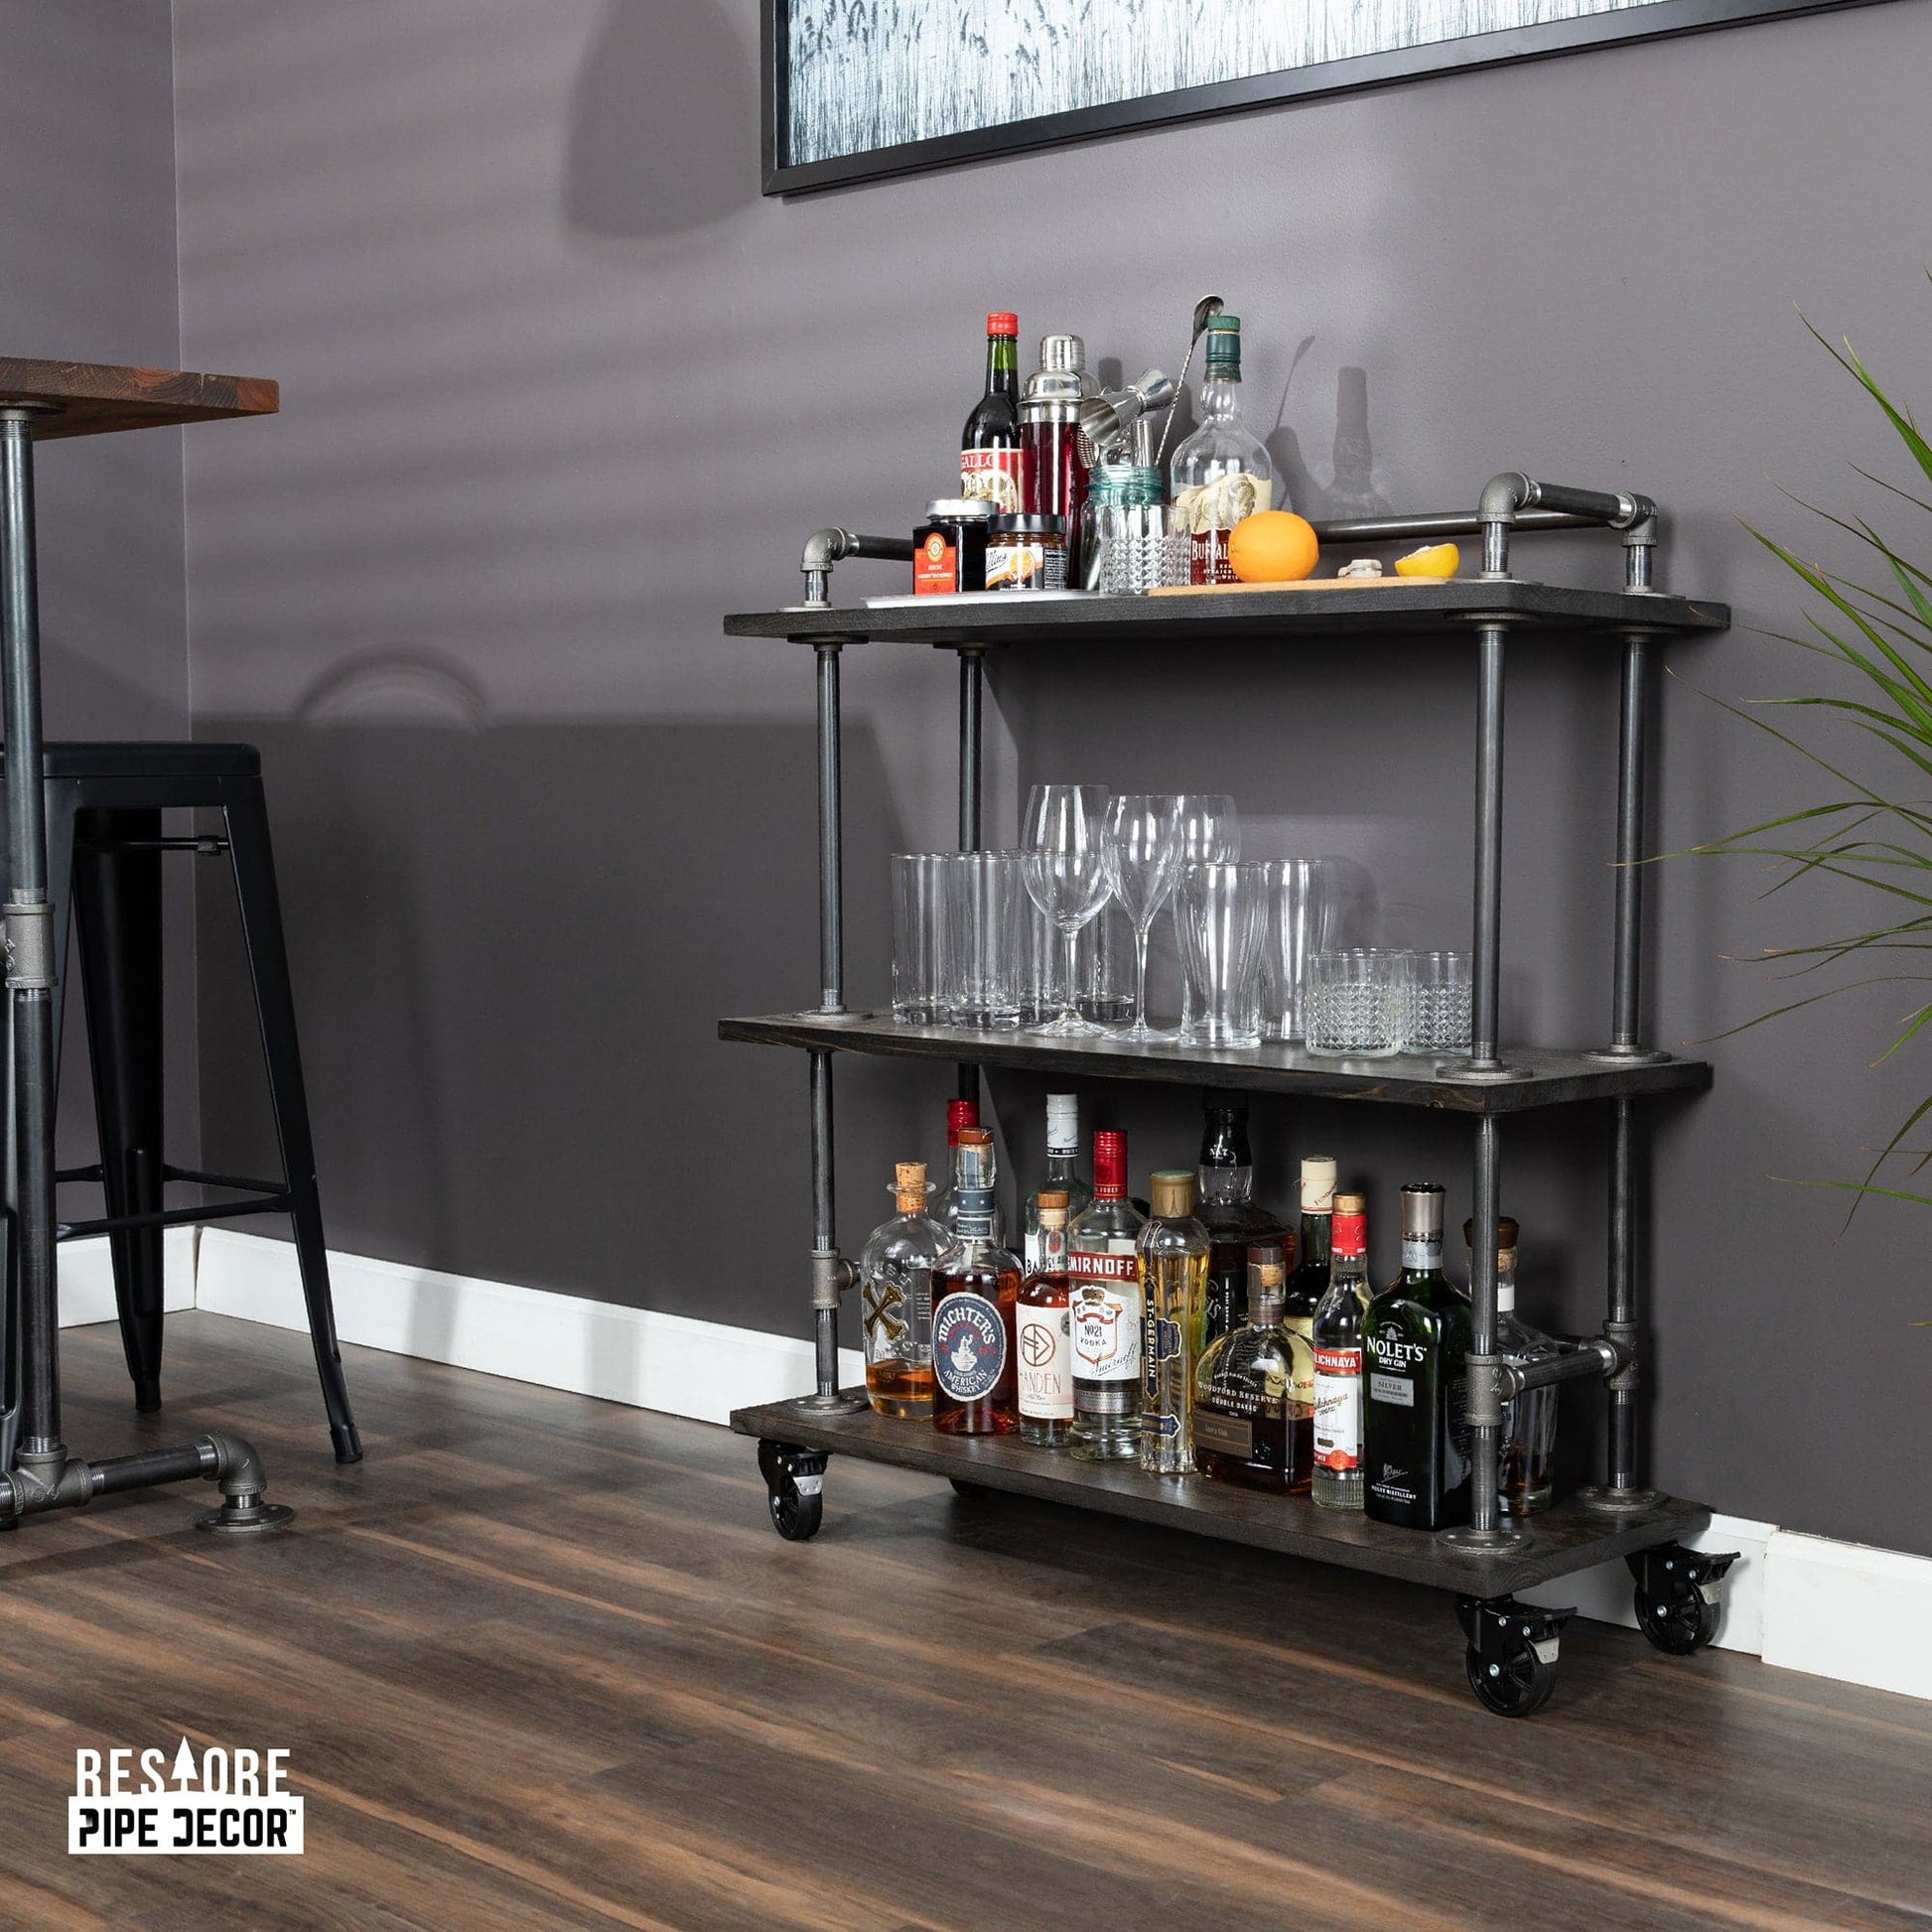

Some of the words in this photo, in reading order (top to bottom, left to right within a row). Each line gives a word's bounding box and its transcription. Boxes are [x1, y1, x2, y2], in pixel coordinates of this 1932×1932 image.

[1146, 1299, 1158, 1378] ST-GERMAIN
[1366, 1335, 1425, 1362] NOLET'S
[1379, 1356, 1393, 1366] DRY
[1393, 1359, 1407, 1368] GIN
[944, 1369, 988, 1387] AMERICAN
